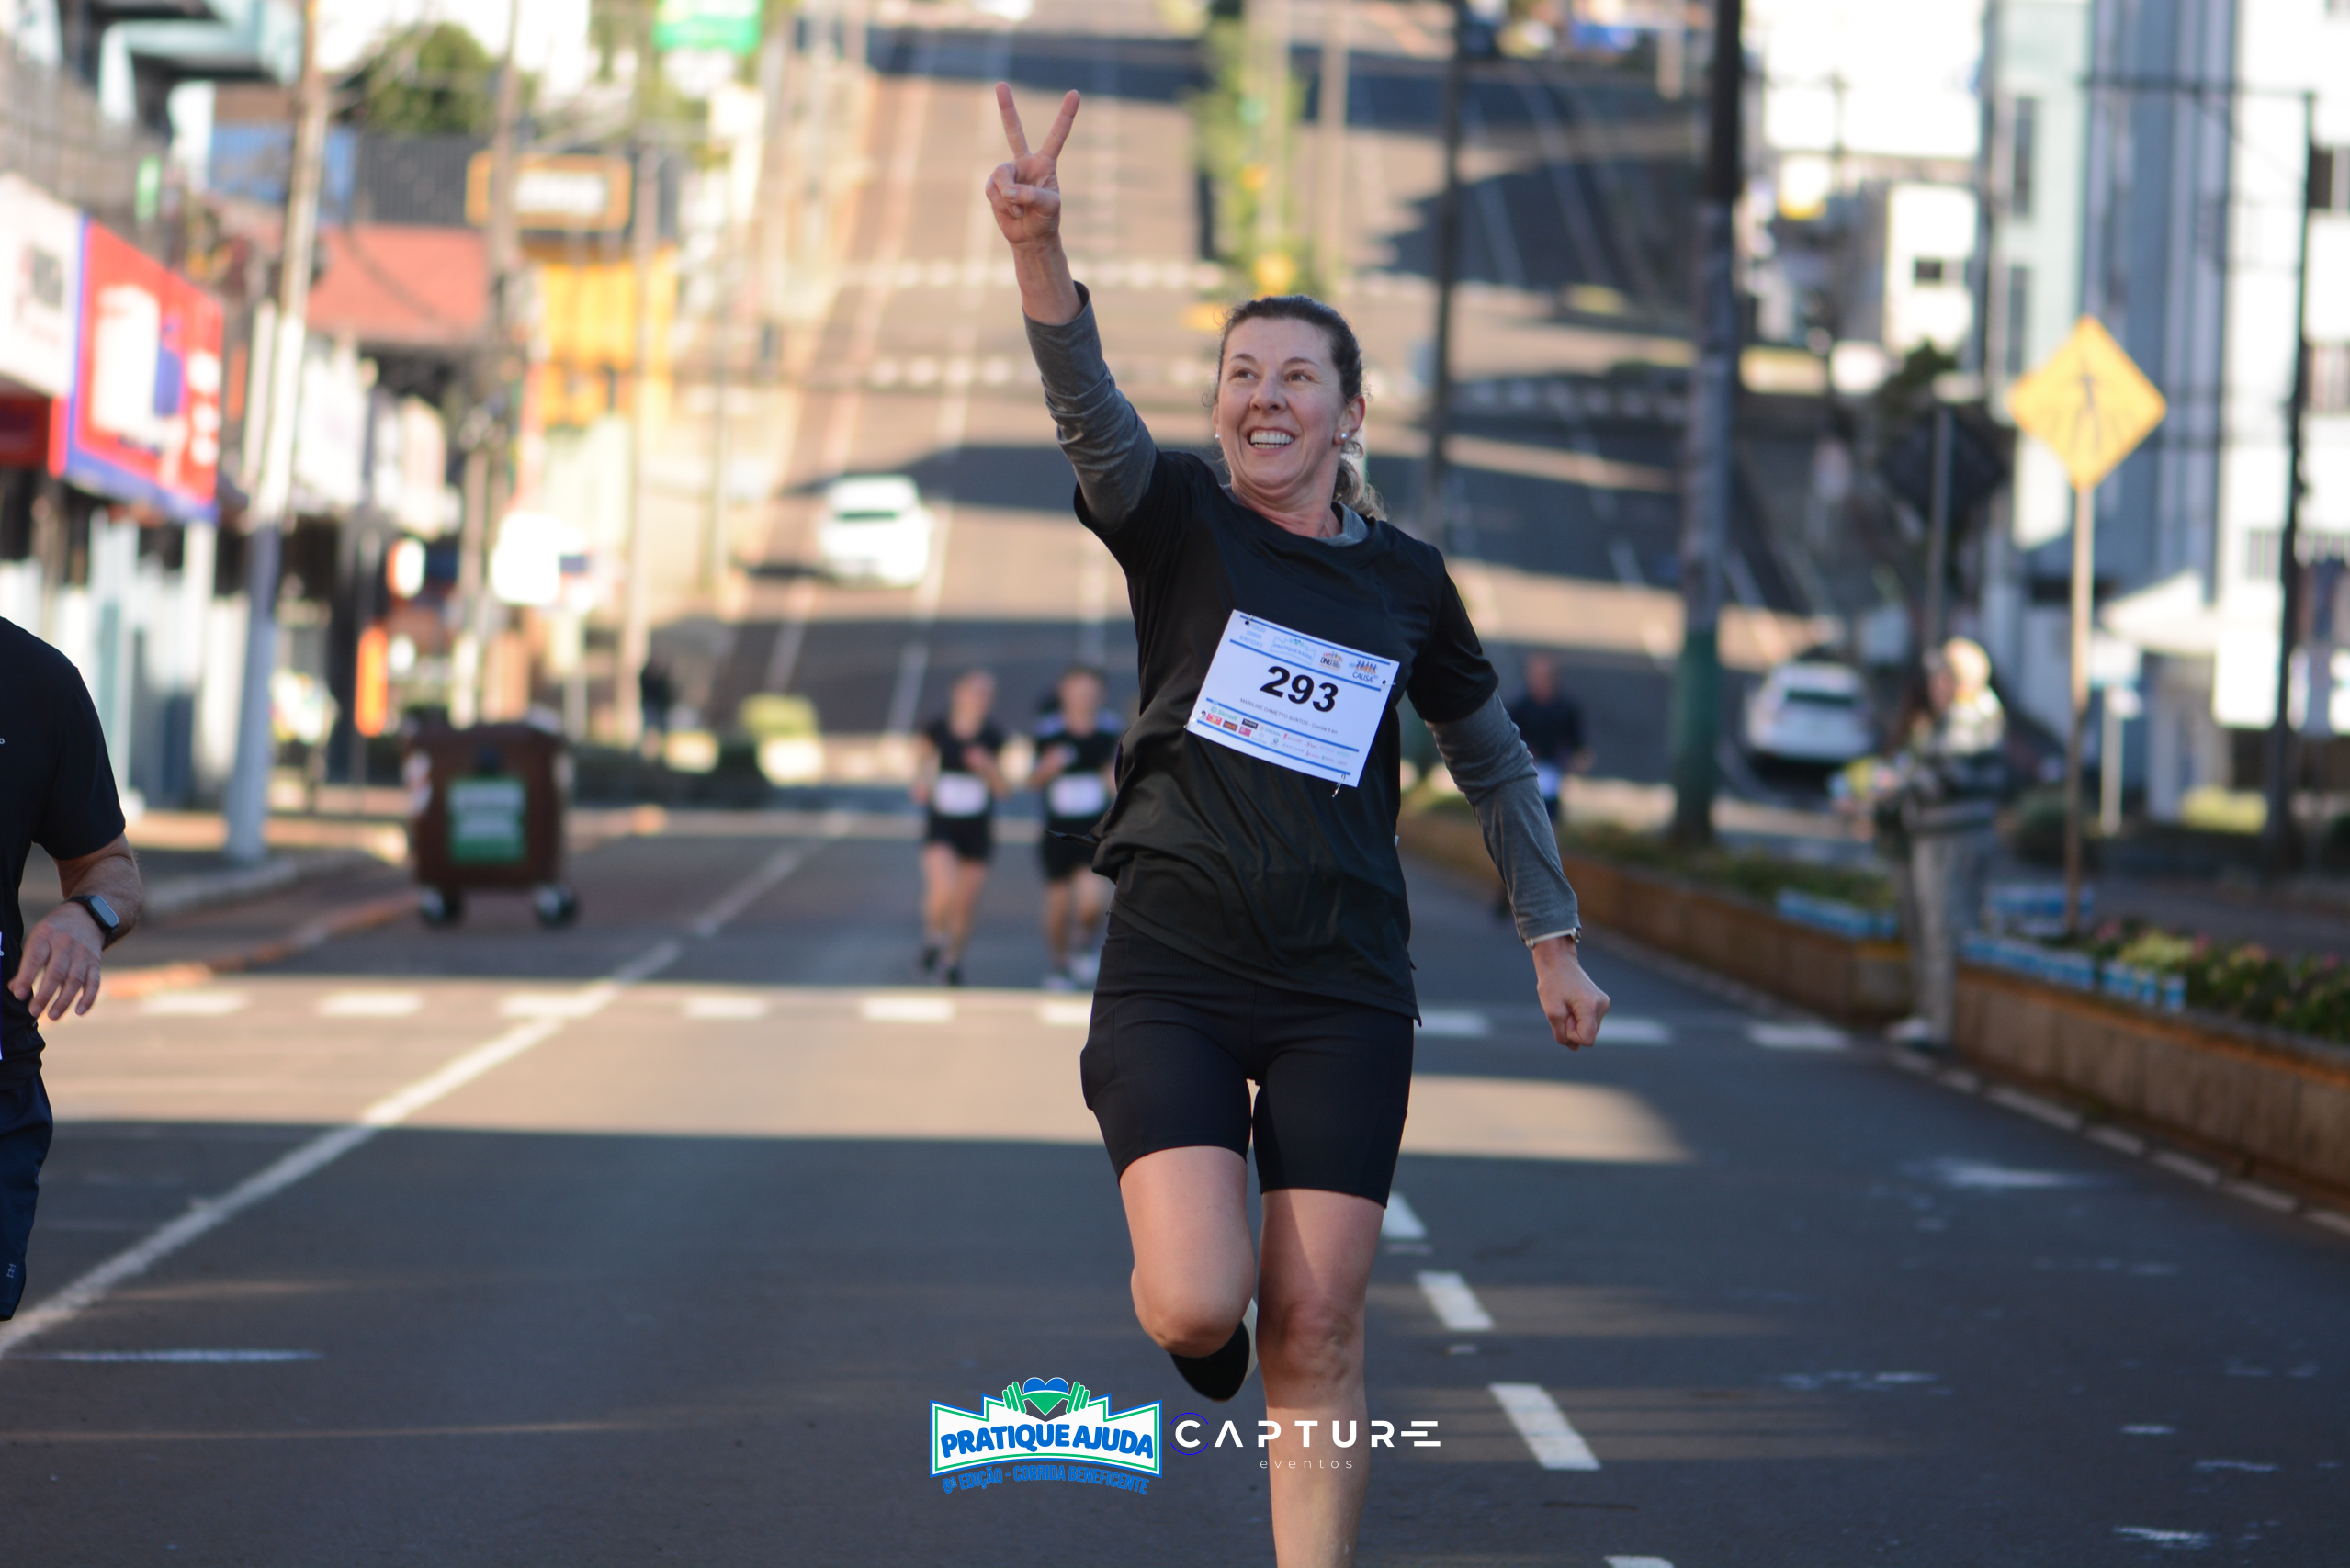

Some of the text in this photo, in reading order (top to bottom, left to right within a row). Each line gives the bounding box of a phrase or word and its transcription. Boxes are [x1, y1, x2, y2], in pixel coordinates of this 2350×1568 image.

[1260, 666, 1339, 713] 293
[1352, 671, 1373, 683] CAUSA
[1240, 697, 1263, 711] MARILISE
[1264, 706, 1288, 719] DAMETTO
[1289, 716, 1309, 727] SANTOS
[1312, 722, 1328, 733] Corrida
